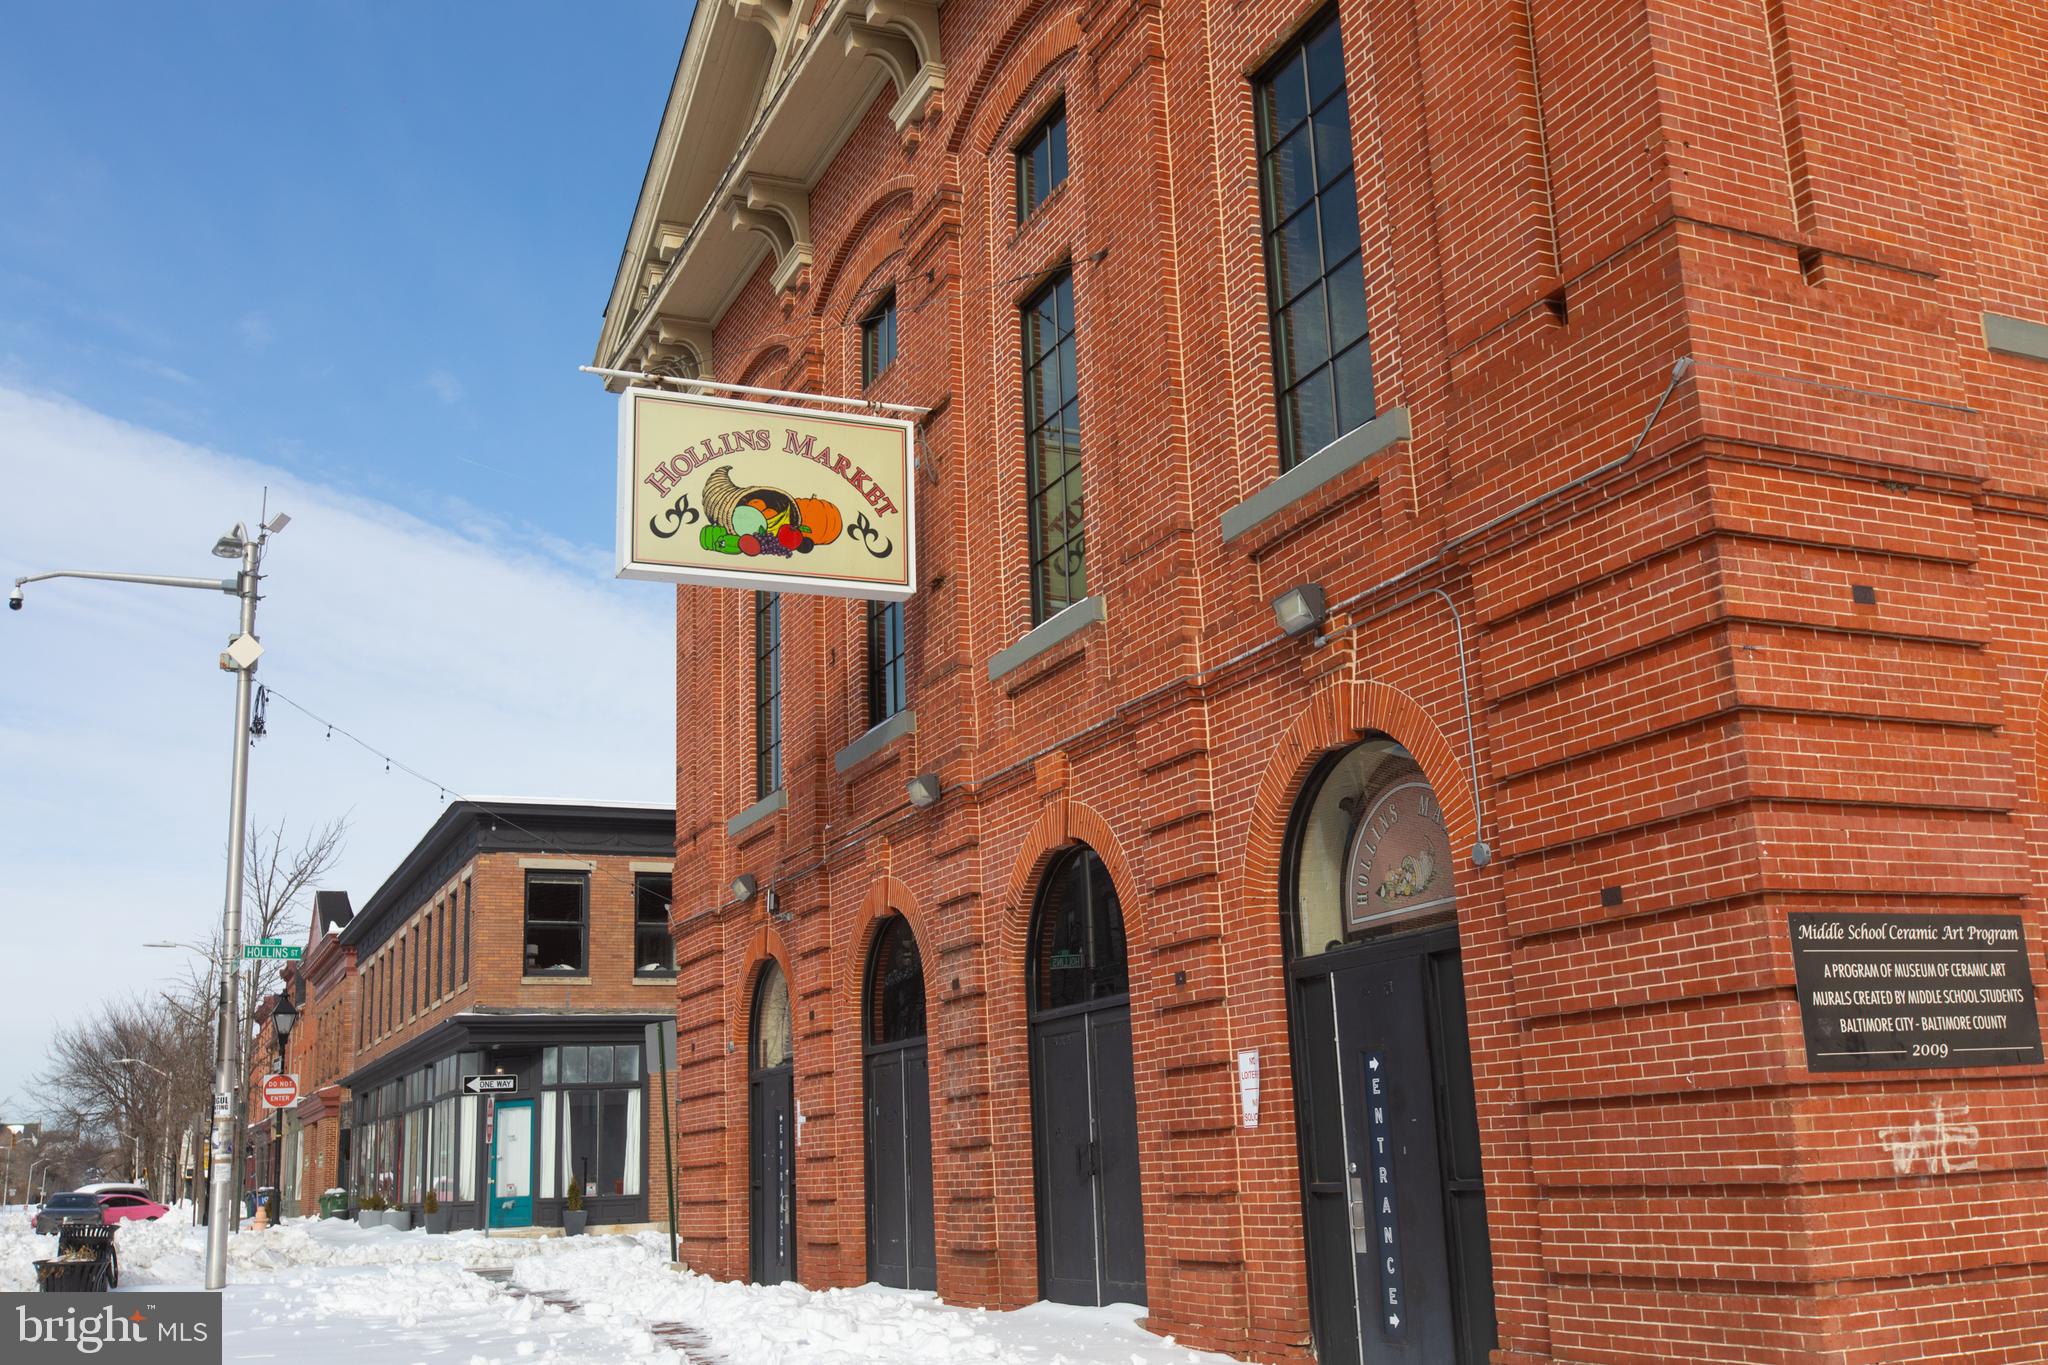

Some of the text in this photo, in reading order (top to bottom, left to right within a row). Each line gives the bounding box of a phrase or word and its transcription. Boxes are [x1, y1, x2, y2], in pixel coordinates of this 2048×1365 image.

[643, 428, 898, 518] HOLLINS MARKET
[1356, 803, 1399, 906] HOLLINS
[1798, 922, 2019, 946] Middle School Ceramic Art Program
[247, 946, 299, 958] HOLLINS ST
[1824, 963, 2006, 979] A PROGRAM OF MUSEUM OF CERAMIC ART
[1812, 988, 2024, 1006] MURALS CREATED BY MIDDLE SCHOOL STUDENTS
[1839, 1017, 1894, 1033] BALTIMORE
[1895, 1017, 1914, 1032] CITY
[1921, 1016, 1972, 1032] BALTIMORE
[1973, 1015, 2007, 1031] COUNTY
[1912, 1043, 1949, 1058] 2009
[480, 1080, 512, 1088] ONE WAY
[1371, 1078, 1398, 1305] ENTRANCE
